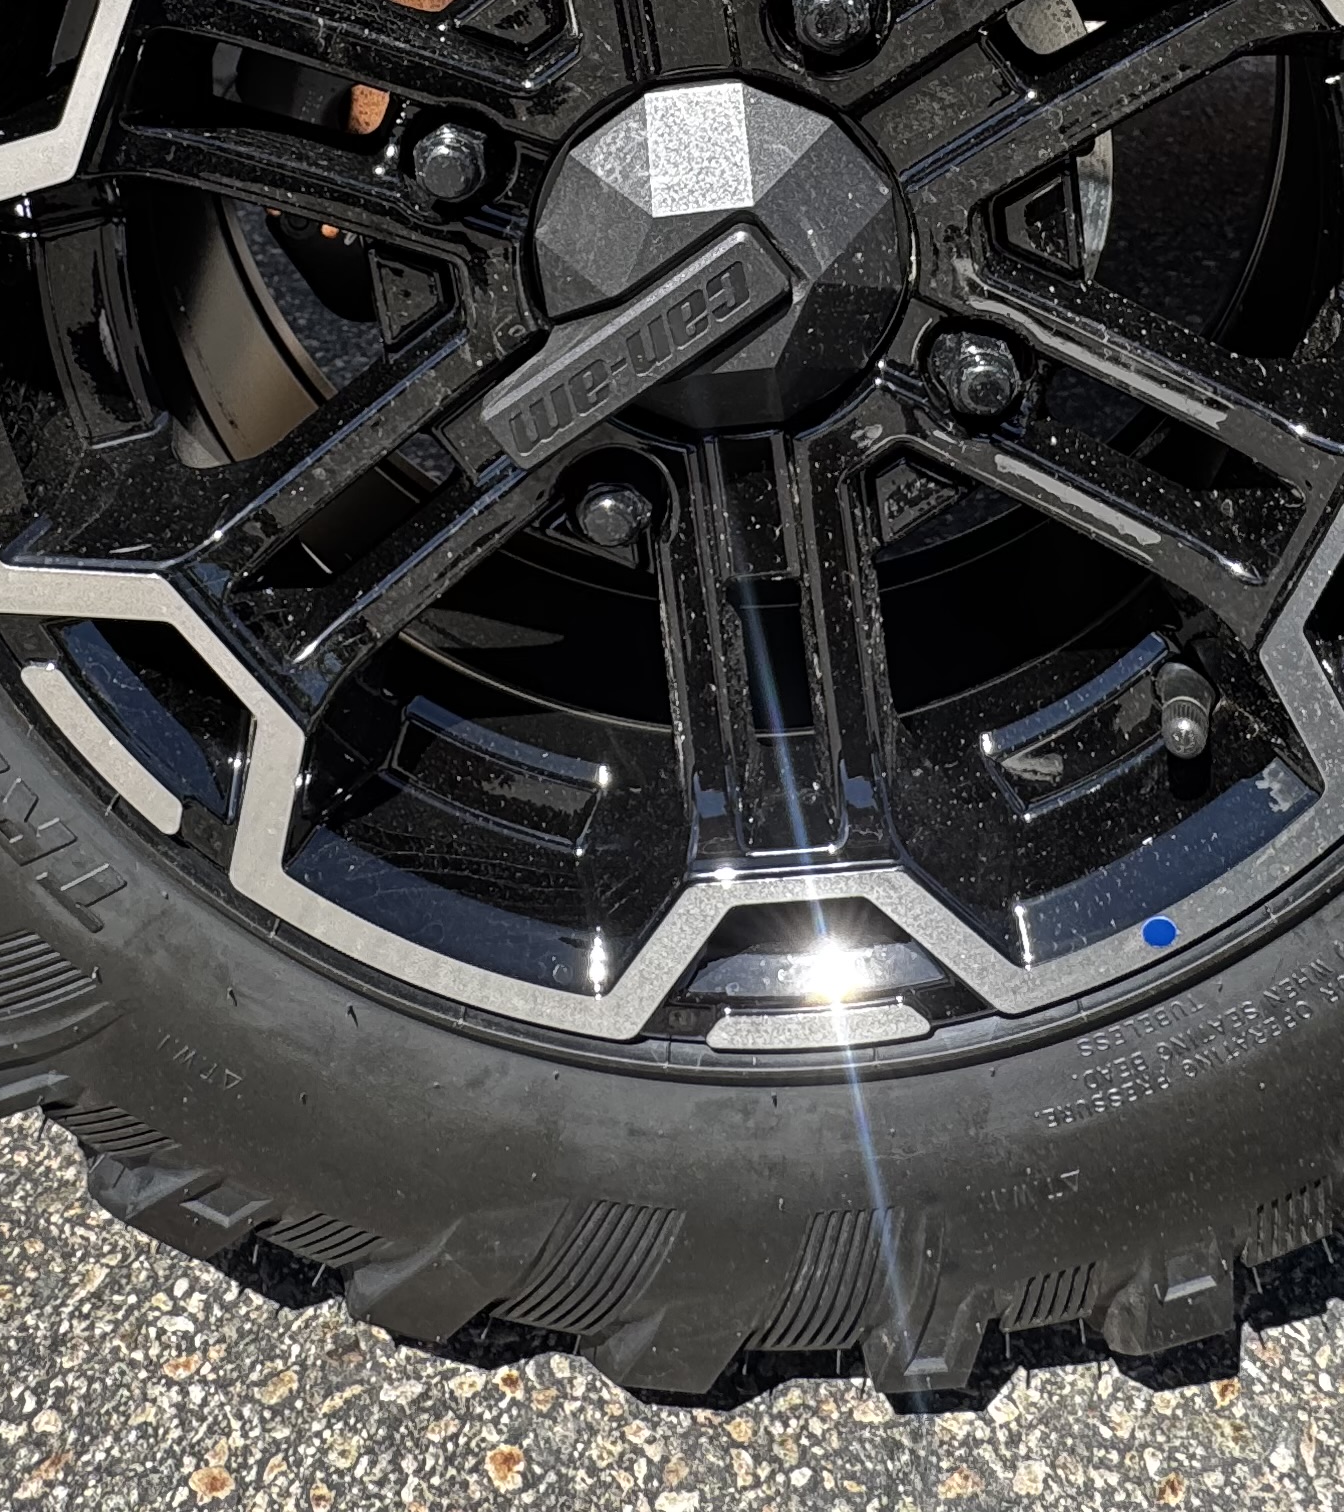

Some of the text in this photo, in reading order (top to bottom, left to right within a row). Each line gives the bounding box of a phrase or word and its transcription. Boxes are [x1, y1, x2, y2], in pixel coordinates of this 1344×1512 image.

[507, 259, 752, 458] can-am
[1263, 958, 1334, 1004] WHEN
[1077, 993, 1206, 1057] TUBELESS
[1156, 1000, 1259, 1061] SEATING
[1181, 1000, 1314, 1079] OPERATING
